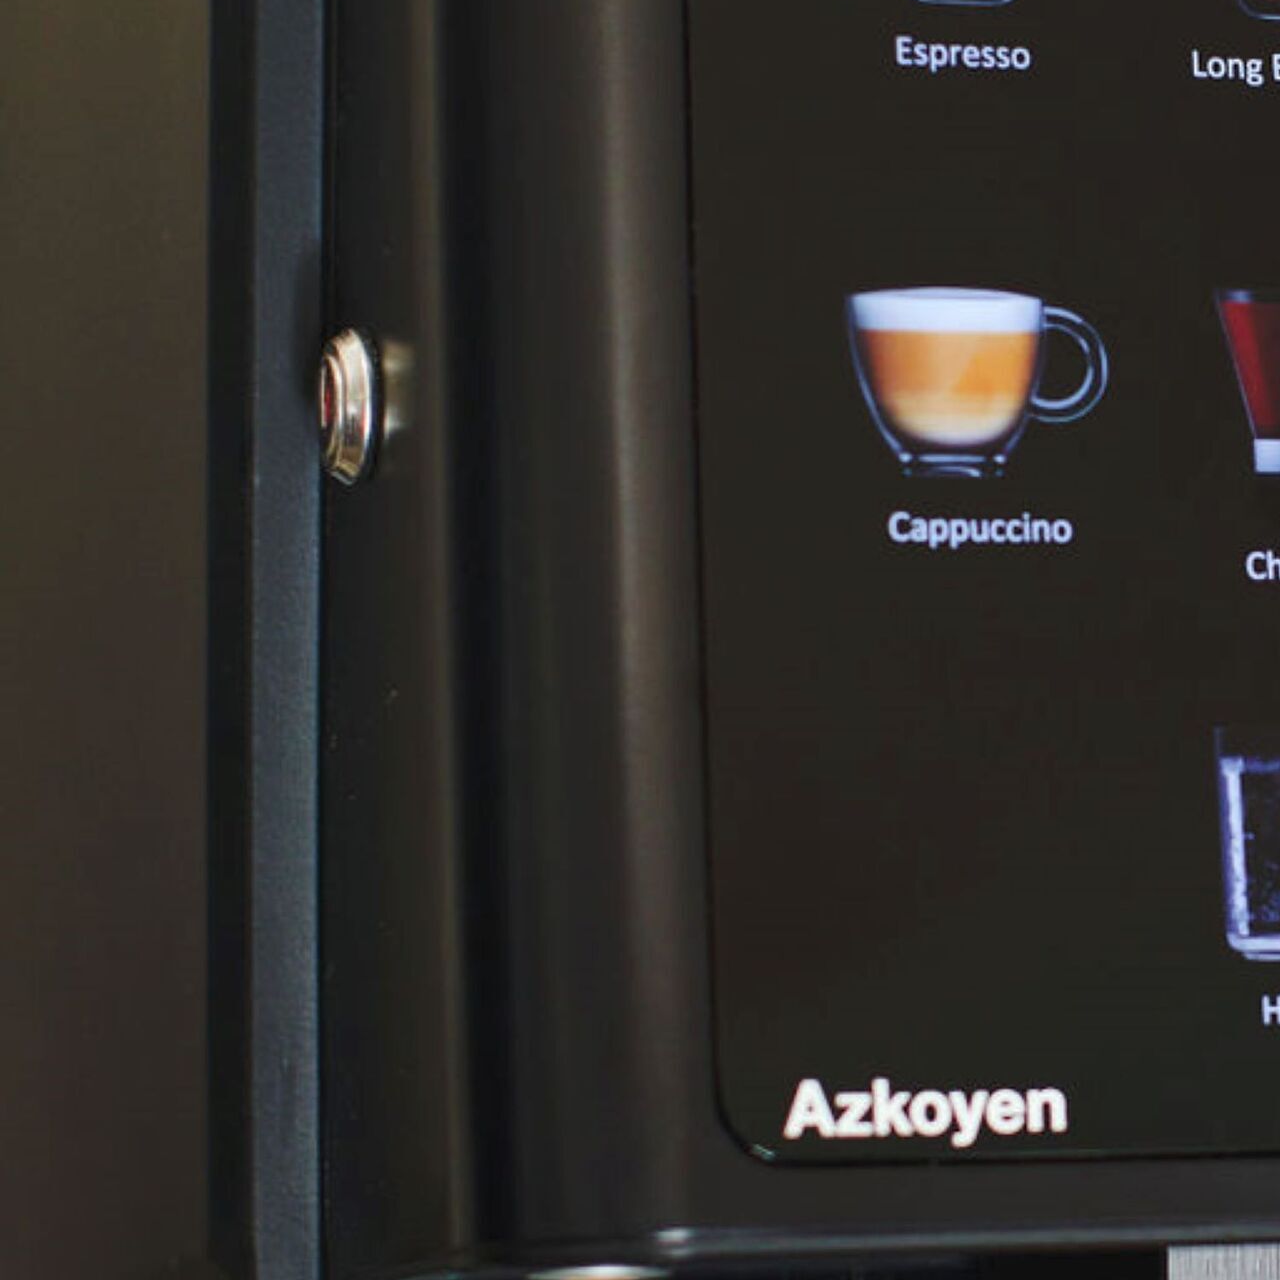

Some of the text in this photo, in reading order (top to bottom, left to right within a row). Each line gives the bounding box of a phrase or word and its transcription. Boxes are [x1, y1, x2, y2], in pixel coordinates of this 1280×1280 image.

[895, 35, 1031, 73] Espresso
[1191, 49, 1265, 87] Long
[887, 510, 1074, 550] Cappuccino
[783, 1077, 1068, 1148] Azkoyen
